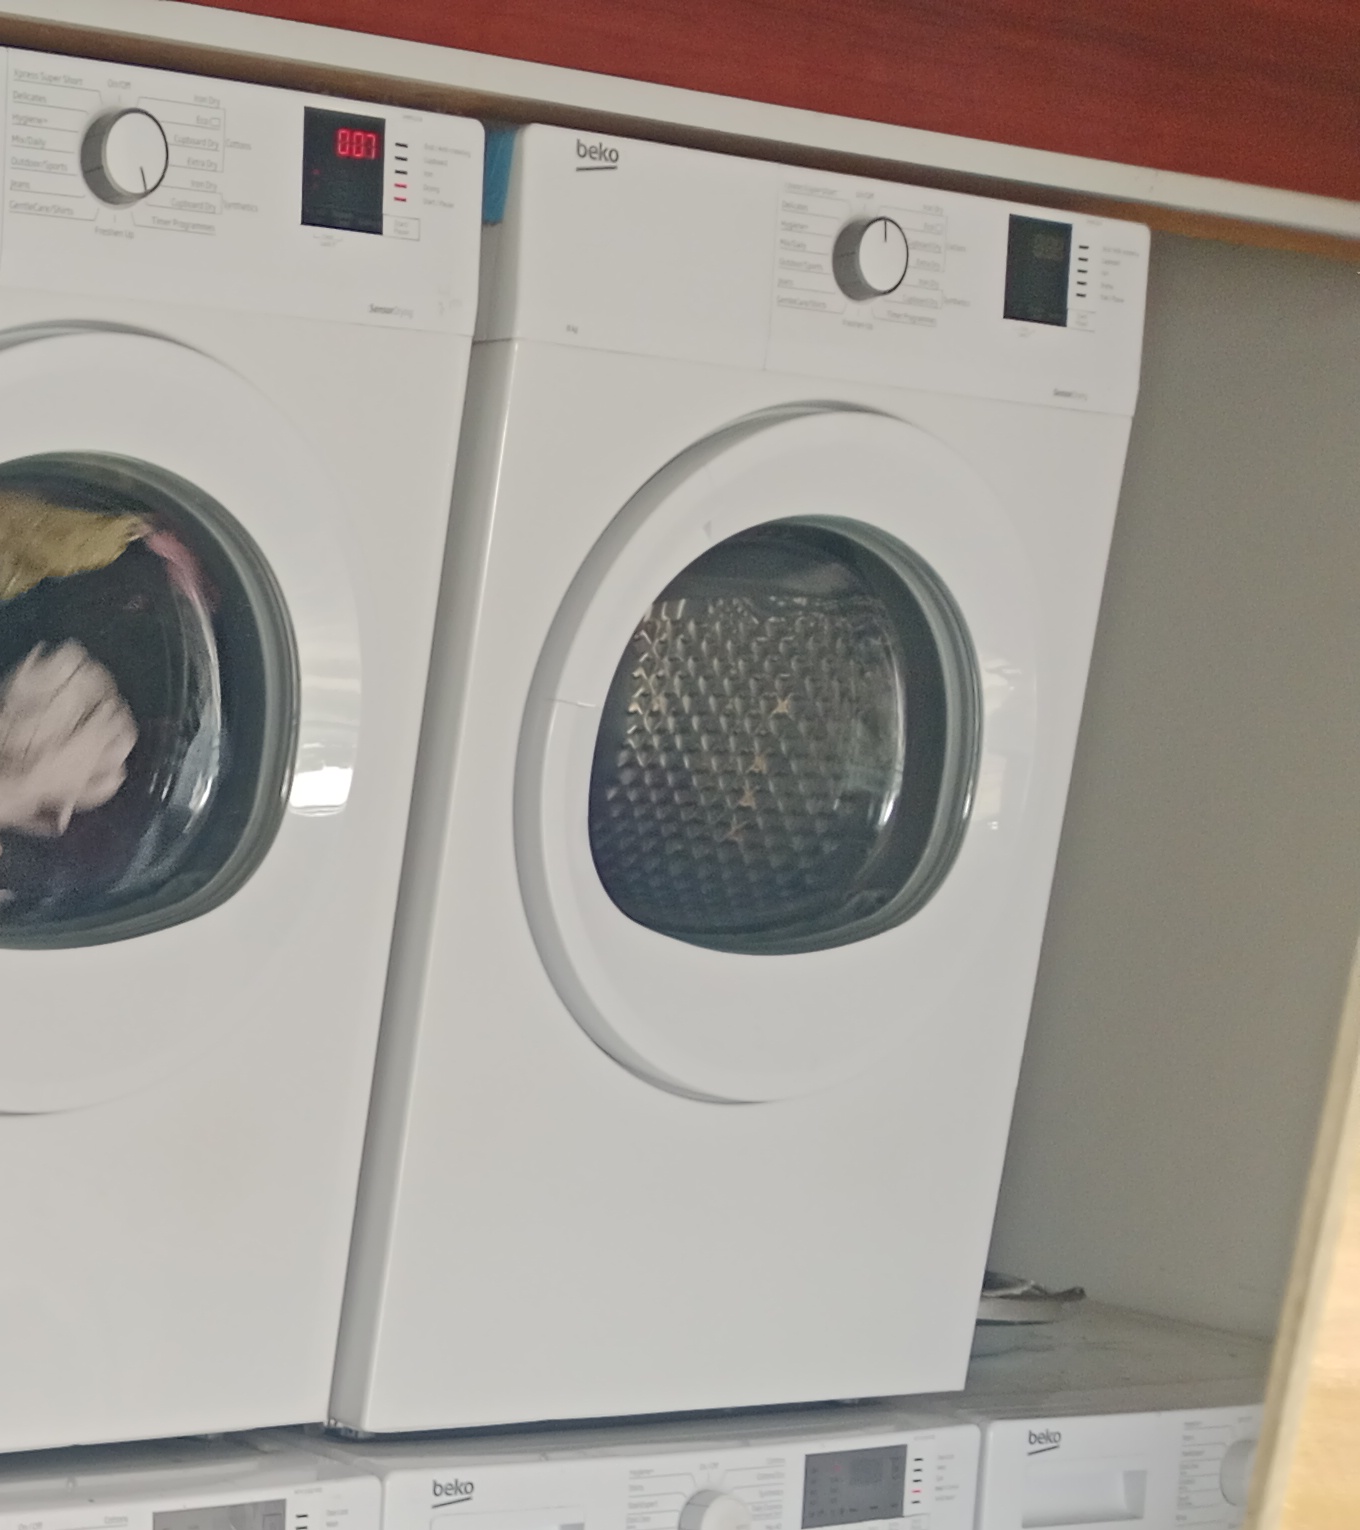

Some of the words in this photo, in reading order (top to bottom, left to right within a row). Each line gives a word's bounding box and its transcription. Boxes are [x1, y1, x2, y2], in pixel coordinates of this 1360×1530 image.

[576, 138, 620, 163] beko
[1028, 1429, 1062, 1446] beko
[432, 1478, 475, 1497] beko
